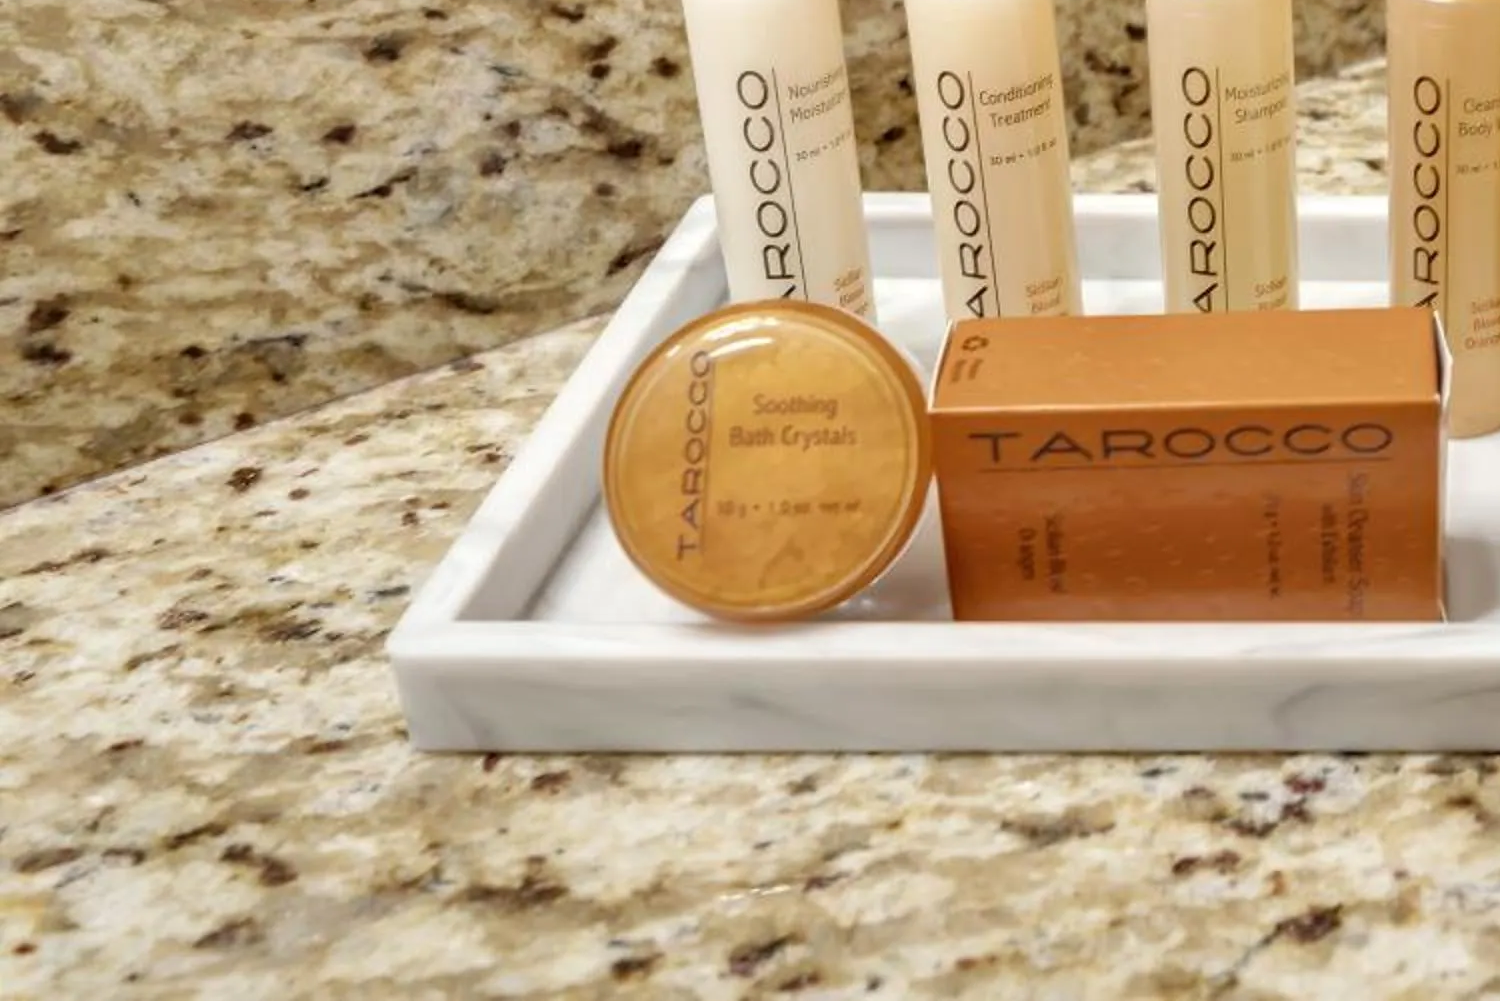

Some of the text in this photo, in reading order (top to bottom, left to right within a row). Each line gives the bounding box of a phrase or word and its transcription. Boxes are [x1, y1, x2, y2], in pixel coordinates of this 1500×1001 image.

[979, 73, 1055, 106] Conditioning
[989, 95, 1051, 128] Treatment
[1457, 120, 1494, 139] Body
[736, 69, 796, 299] ROCCO
[937, 69, 989, 319] AROCCO
[1181, 66, 1219, 313] AROCCO
[1413, 75, 1441, 308] ROCCO
[753, 393, 838, 420] Soothing
[677, 350, 710, 561] TAROCCO
[729, 424, 857, 453] Bath Crystals
[967, 422, 1394, 465] TAROCCO
